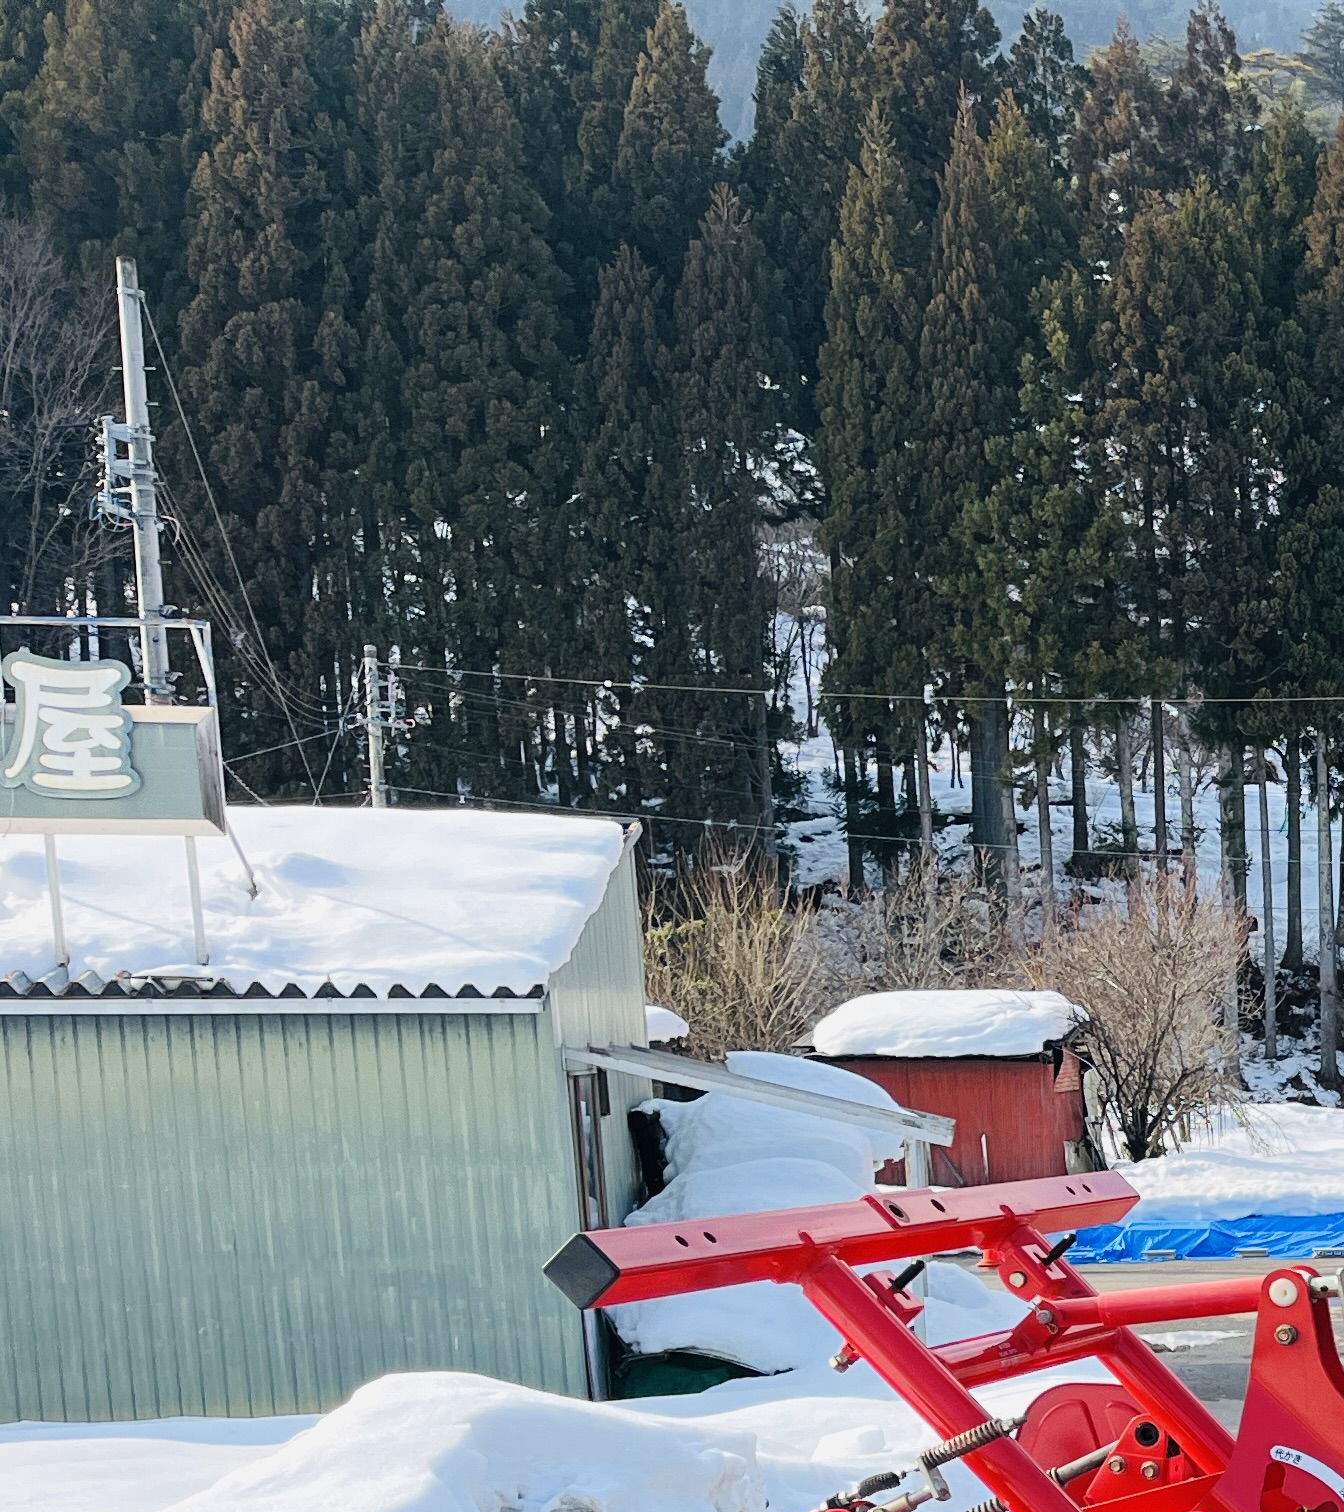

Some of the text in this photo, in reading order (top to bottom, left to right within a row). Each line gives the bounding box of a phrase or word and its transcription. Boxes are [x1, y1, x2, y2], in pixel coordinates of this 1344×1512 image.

[4, 661, 132, 791] 屋
[1274, 1448, 1302, 1464] 代かき
